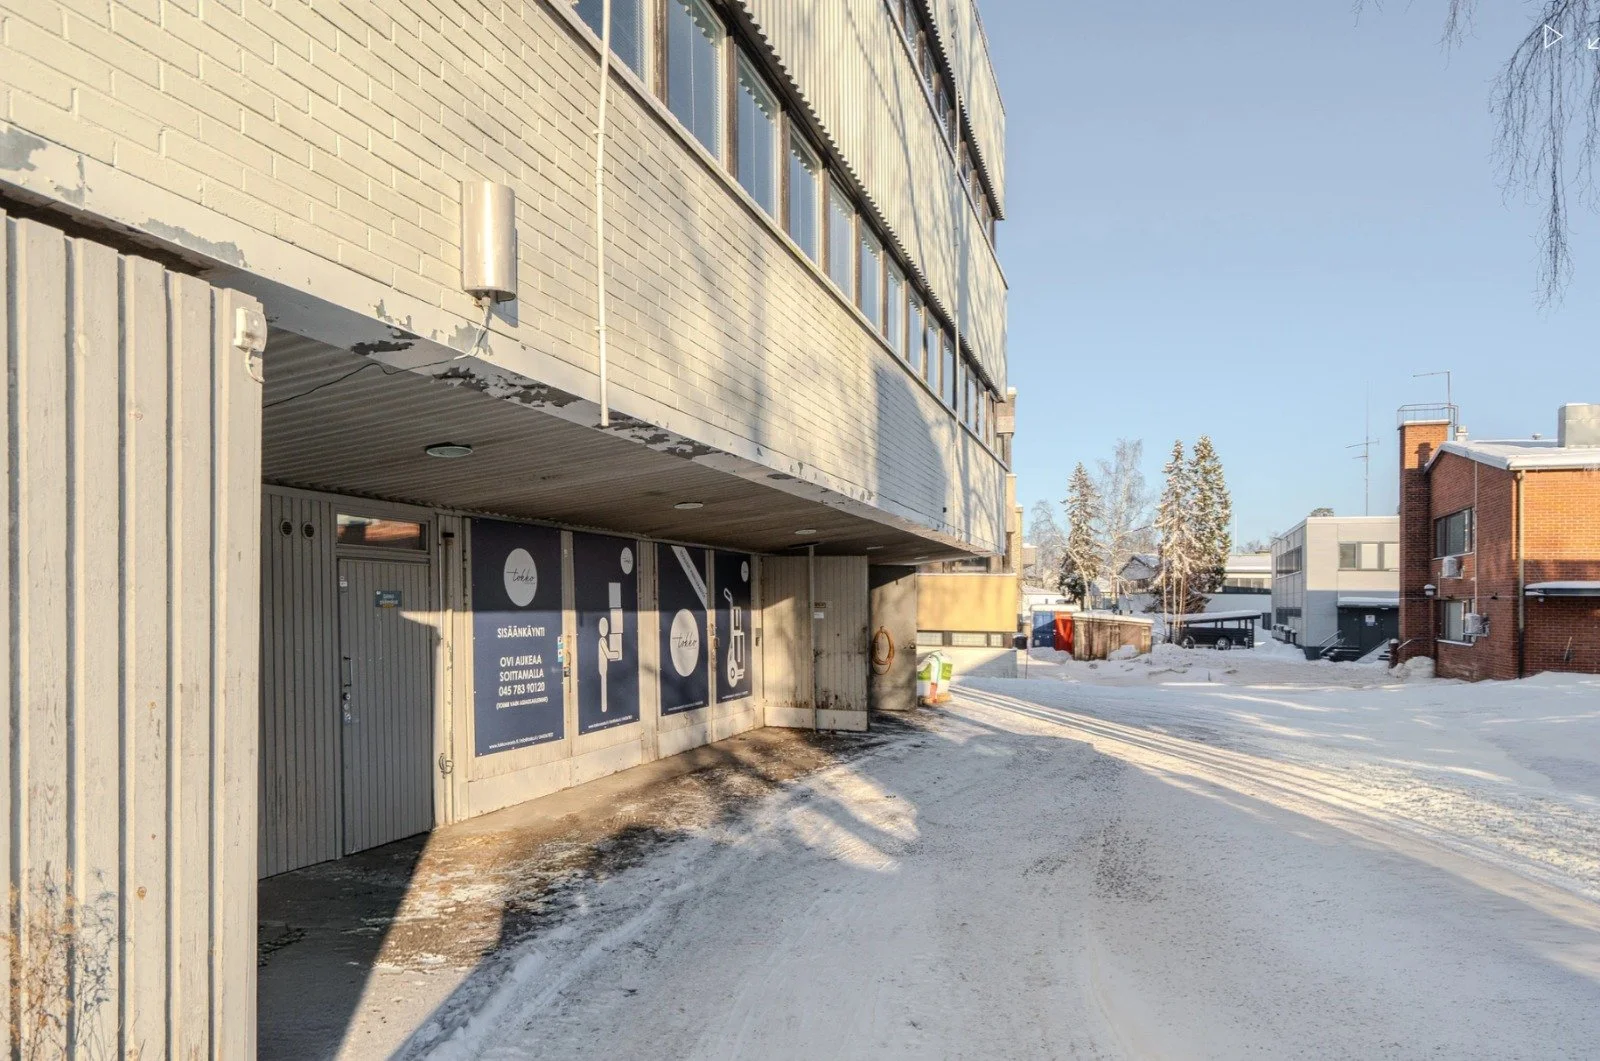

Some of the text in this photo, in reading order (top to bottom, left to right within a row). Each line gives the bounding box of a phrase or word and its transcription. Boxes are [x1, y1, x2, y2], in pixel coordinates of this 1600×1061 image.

[497, 625, 545, 638] SISÄÄNKÄYNTI
[500, 654, 542, 668] OVI AUKEAA
[499, 668, 544, 682] SOITTAMALLA
[498, 682, 545, 697] 045 783 90120
